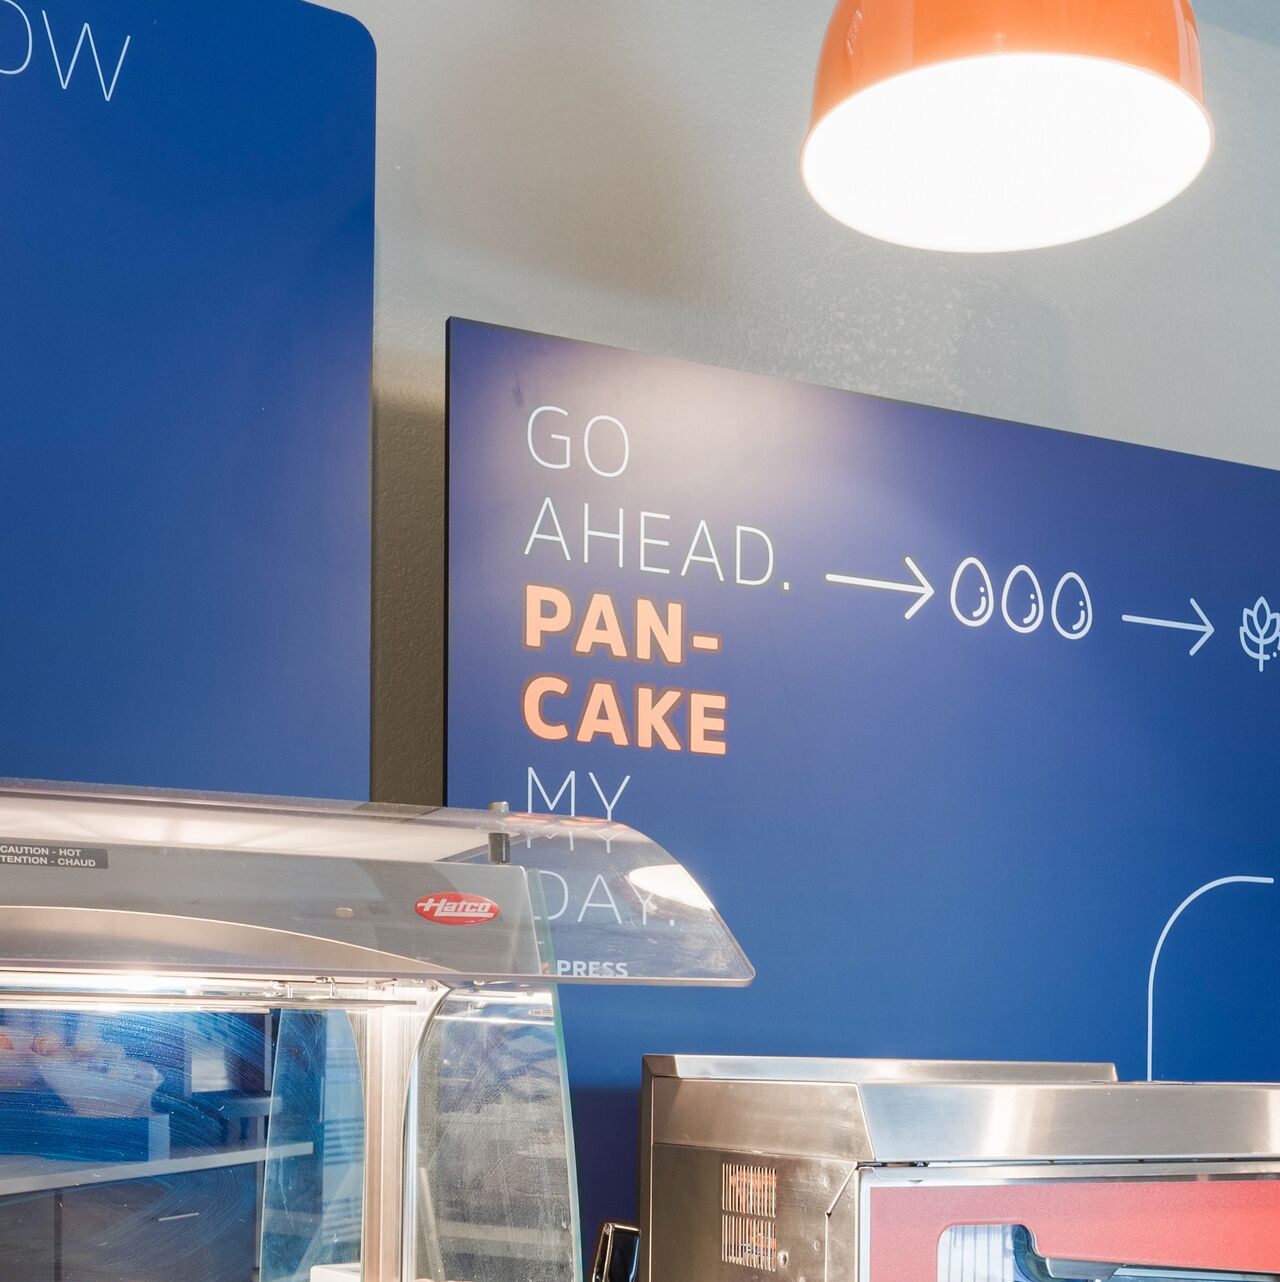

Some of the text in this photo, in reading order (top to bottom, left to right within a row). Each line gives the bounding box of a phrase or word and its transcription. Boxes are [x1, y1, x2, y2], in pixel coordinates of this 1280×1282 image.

[526, 405, 630, 478] GO
[524, 497, 791, 591] AHEAD.
[524, 584, 722, 665] PAN-
[522, 676, 727, 756] CAKE
[526, 766, 631, 824] MY
[0, 845, 50, 856] CAUTION
[58, 848, 82, 857] HOT
[57, 857, 97, 867] CHAUD
[416, 897, 496, 918] Hatco
[531, 869, 675, 926] DAY.
